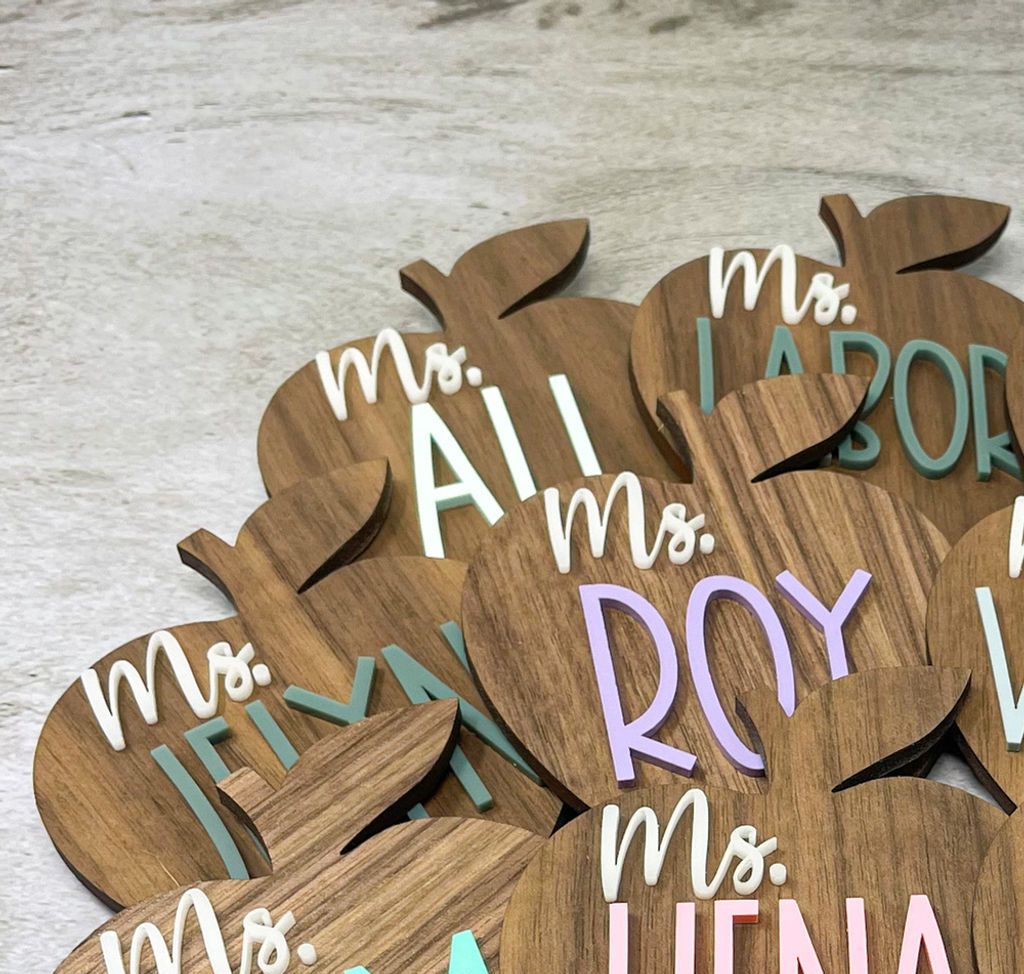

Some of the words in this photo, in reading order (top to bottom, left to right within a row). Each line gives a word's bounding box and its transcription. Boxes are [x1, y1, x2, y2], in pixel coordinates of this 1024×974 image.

[708, 244, 858, 326] Ms.
[315, 327, 483, 421] Ms.
[544, 471, 715, 574] Ms.
[81, 630, 272, 751] Ms.
[578, 568, 873, 789] ROY
[600, 788, 787, 902] Ms.
